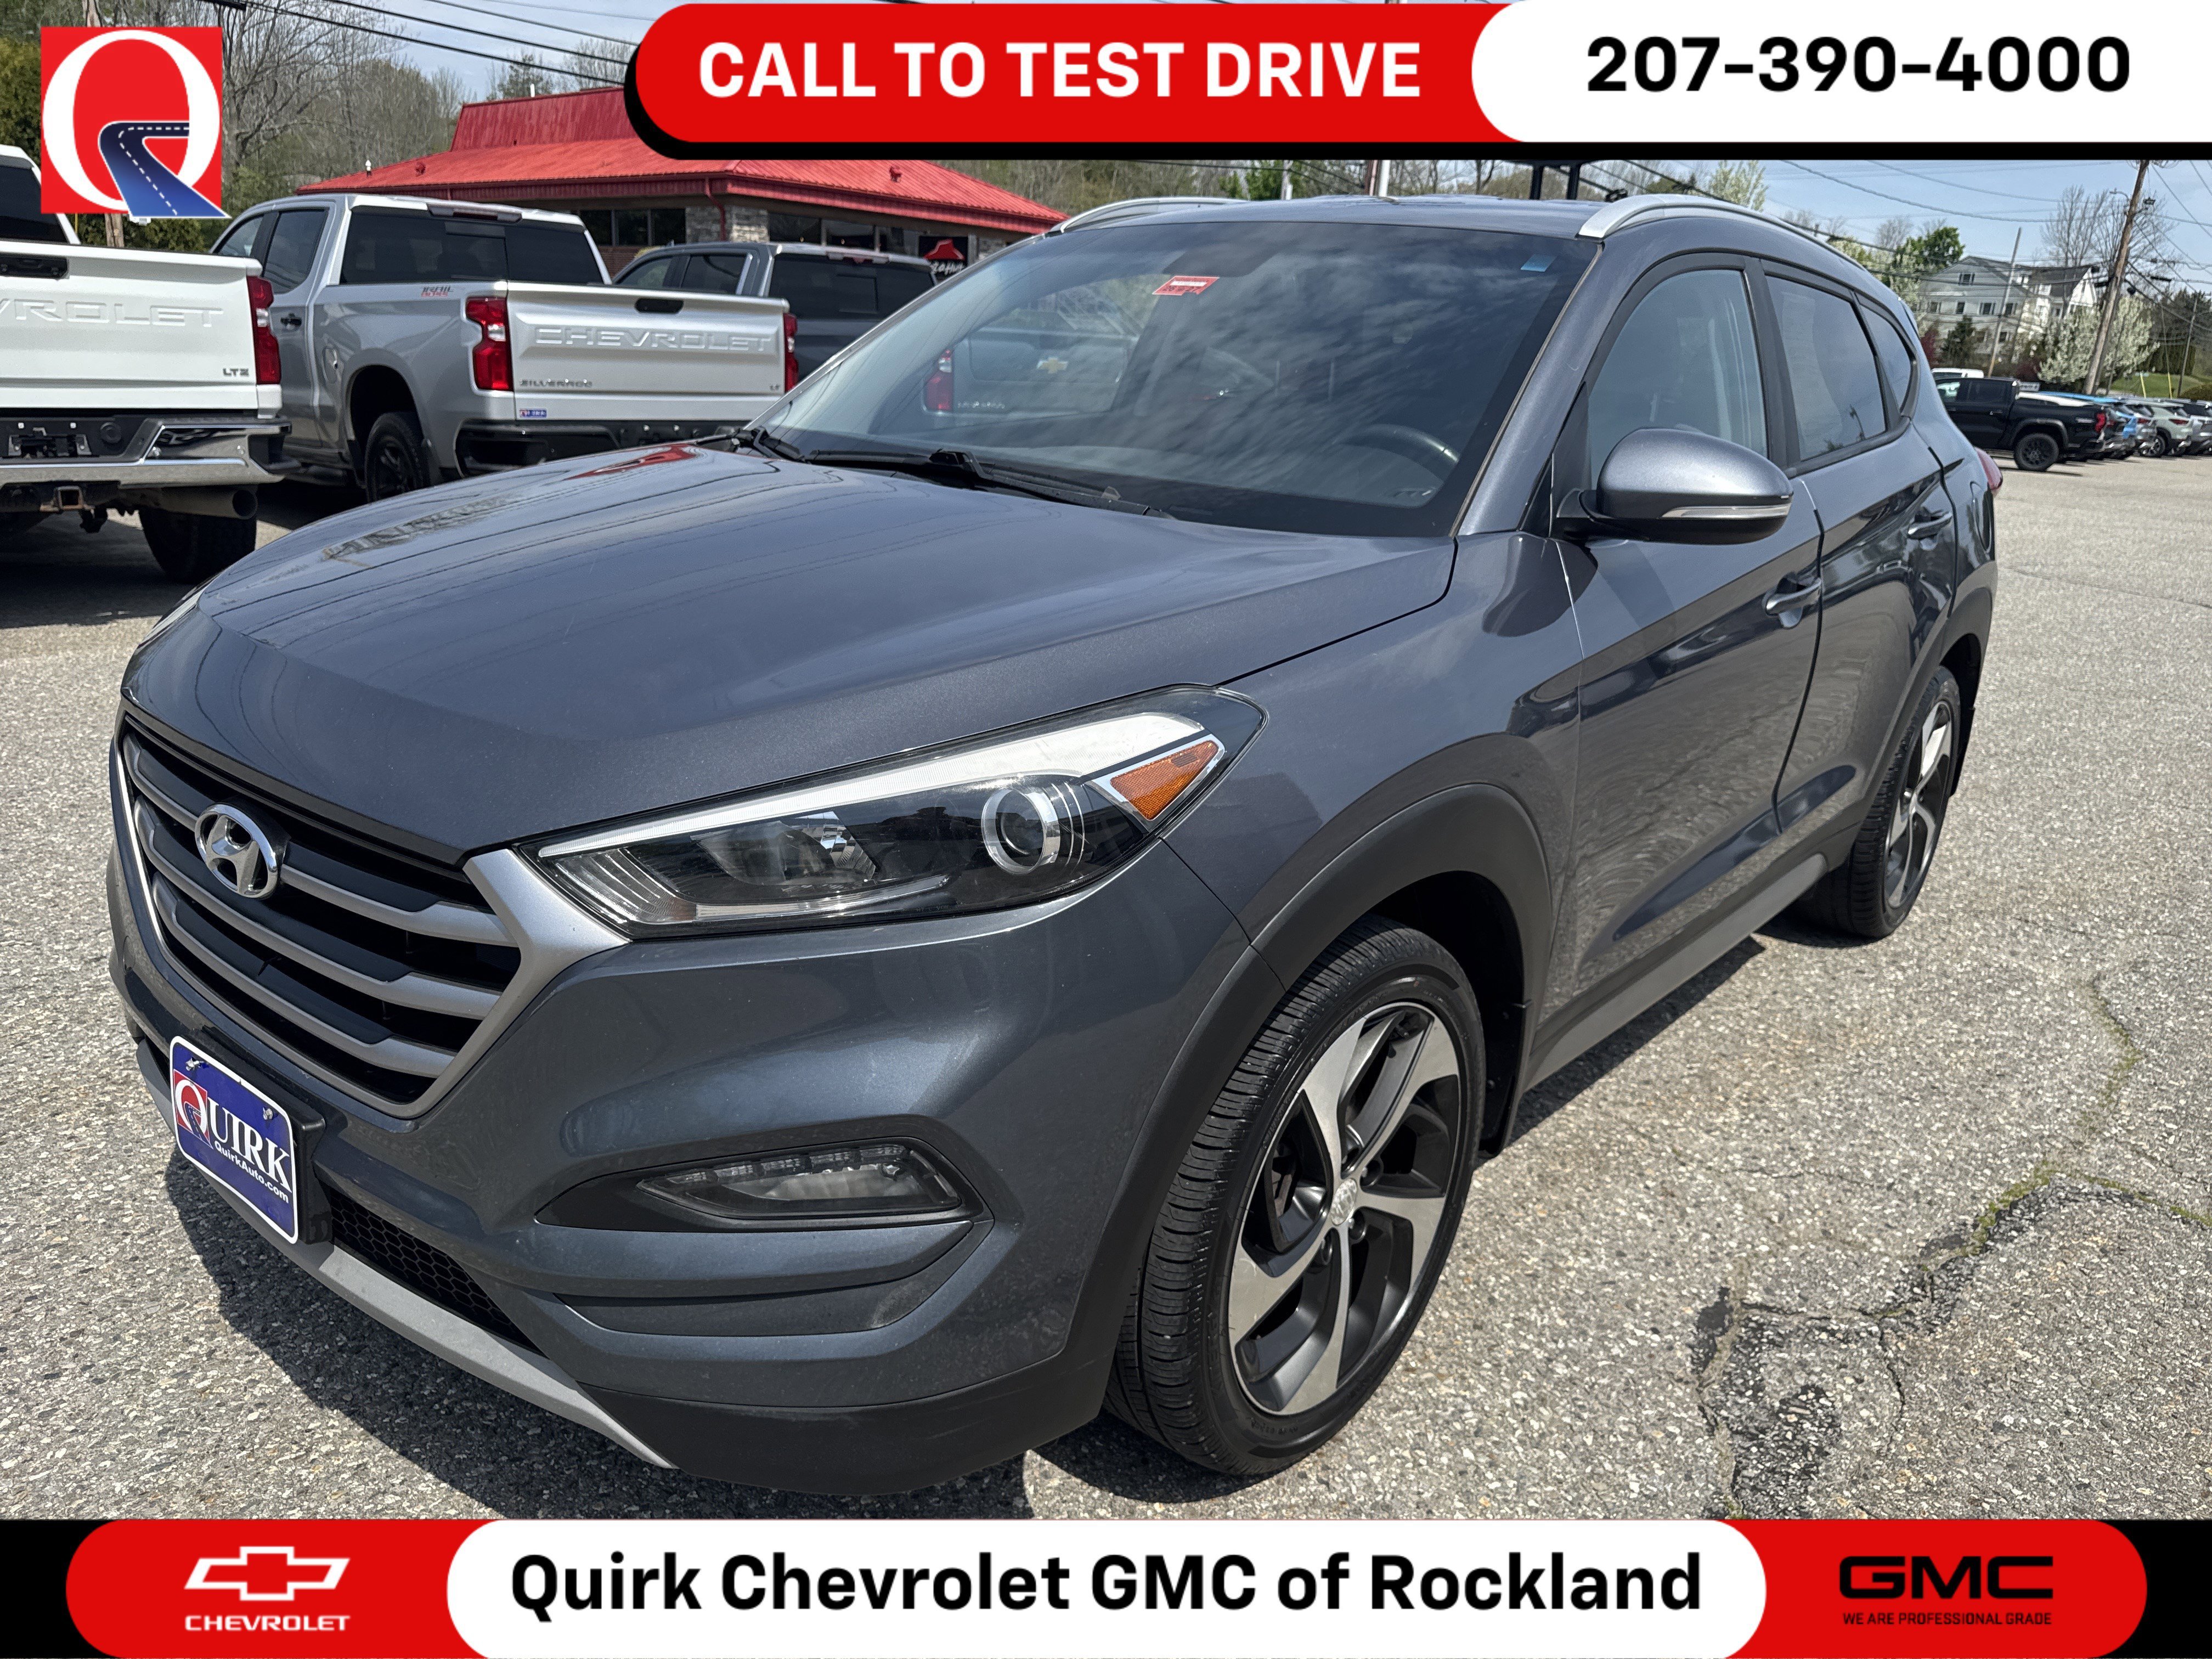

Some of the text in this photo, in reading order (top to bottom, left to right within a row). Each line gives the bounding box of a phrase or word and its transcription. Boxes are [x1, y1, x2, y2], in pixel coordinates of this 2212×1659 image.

[0, 298, 224, 328] ROLET
[536, 328, 771, 352] CHEVROLET
[223, 368, 249, 377] LTZ
[520, 379, 593, 387] SILVERADO
[174, 1078, 292, 1193] QUIRK
[215, 1141, 289, 1204] QuirkAuto.com
